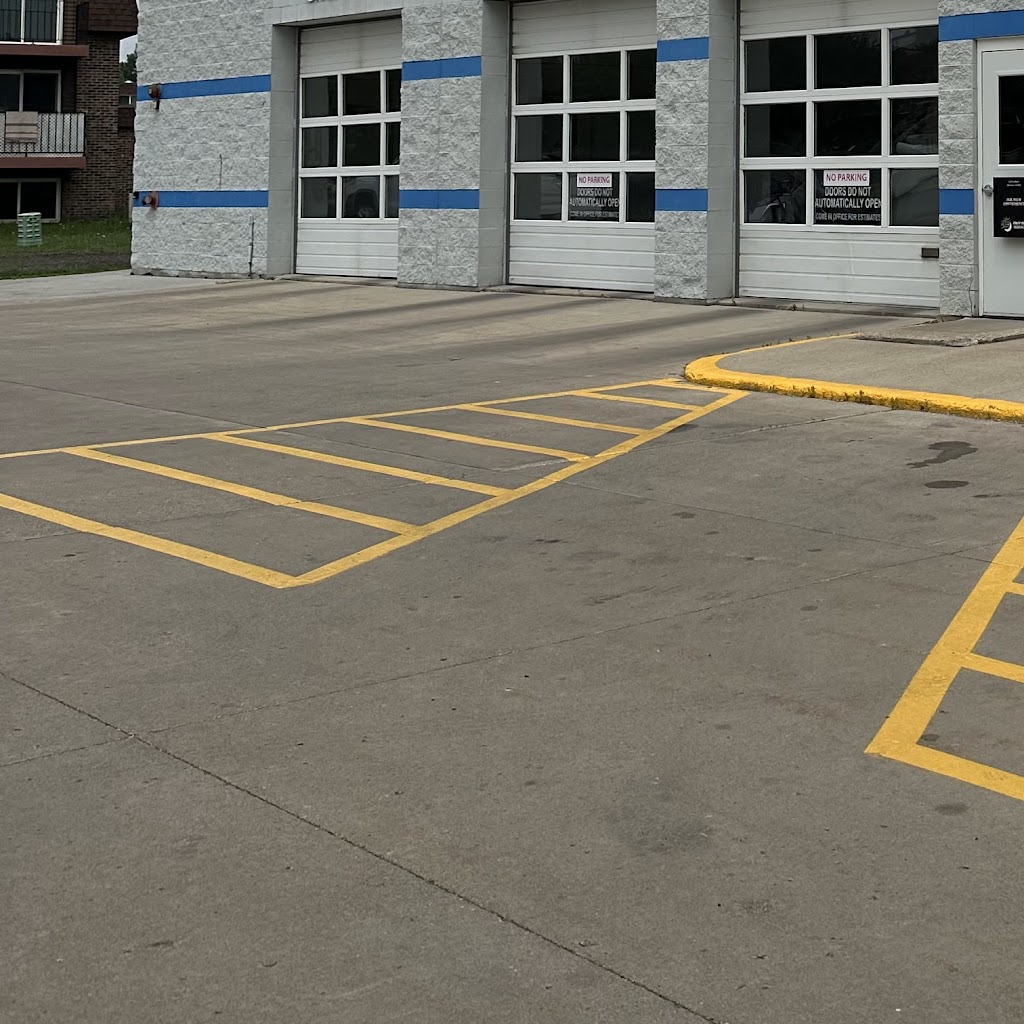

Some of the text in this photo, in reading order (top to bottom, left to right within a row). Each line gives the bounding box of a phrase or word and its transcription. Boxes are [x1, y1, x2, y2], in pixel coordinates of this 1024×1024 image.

[579, 176, 610, 184] NO PARKING
[826, 173, 867, 182] NO PARKING
[577, 187, 613, 196] DOORS DO NOT
[825, 186, 871, 196] DOORS DO NOT
[570, 197, 607, 207] AUTOMATICALLY
[815, 197, 864, 208] AUTOMATICALLY
